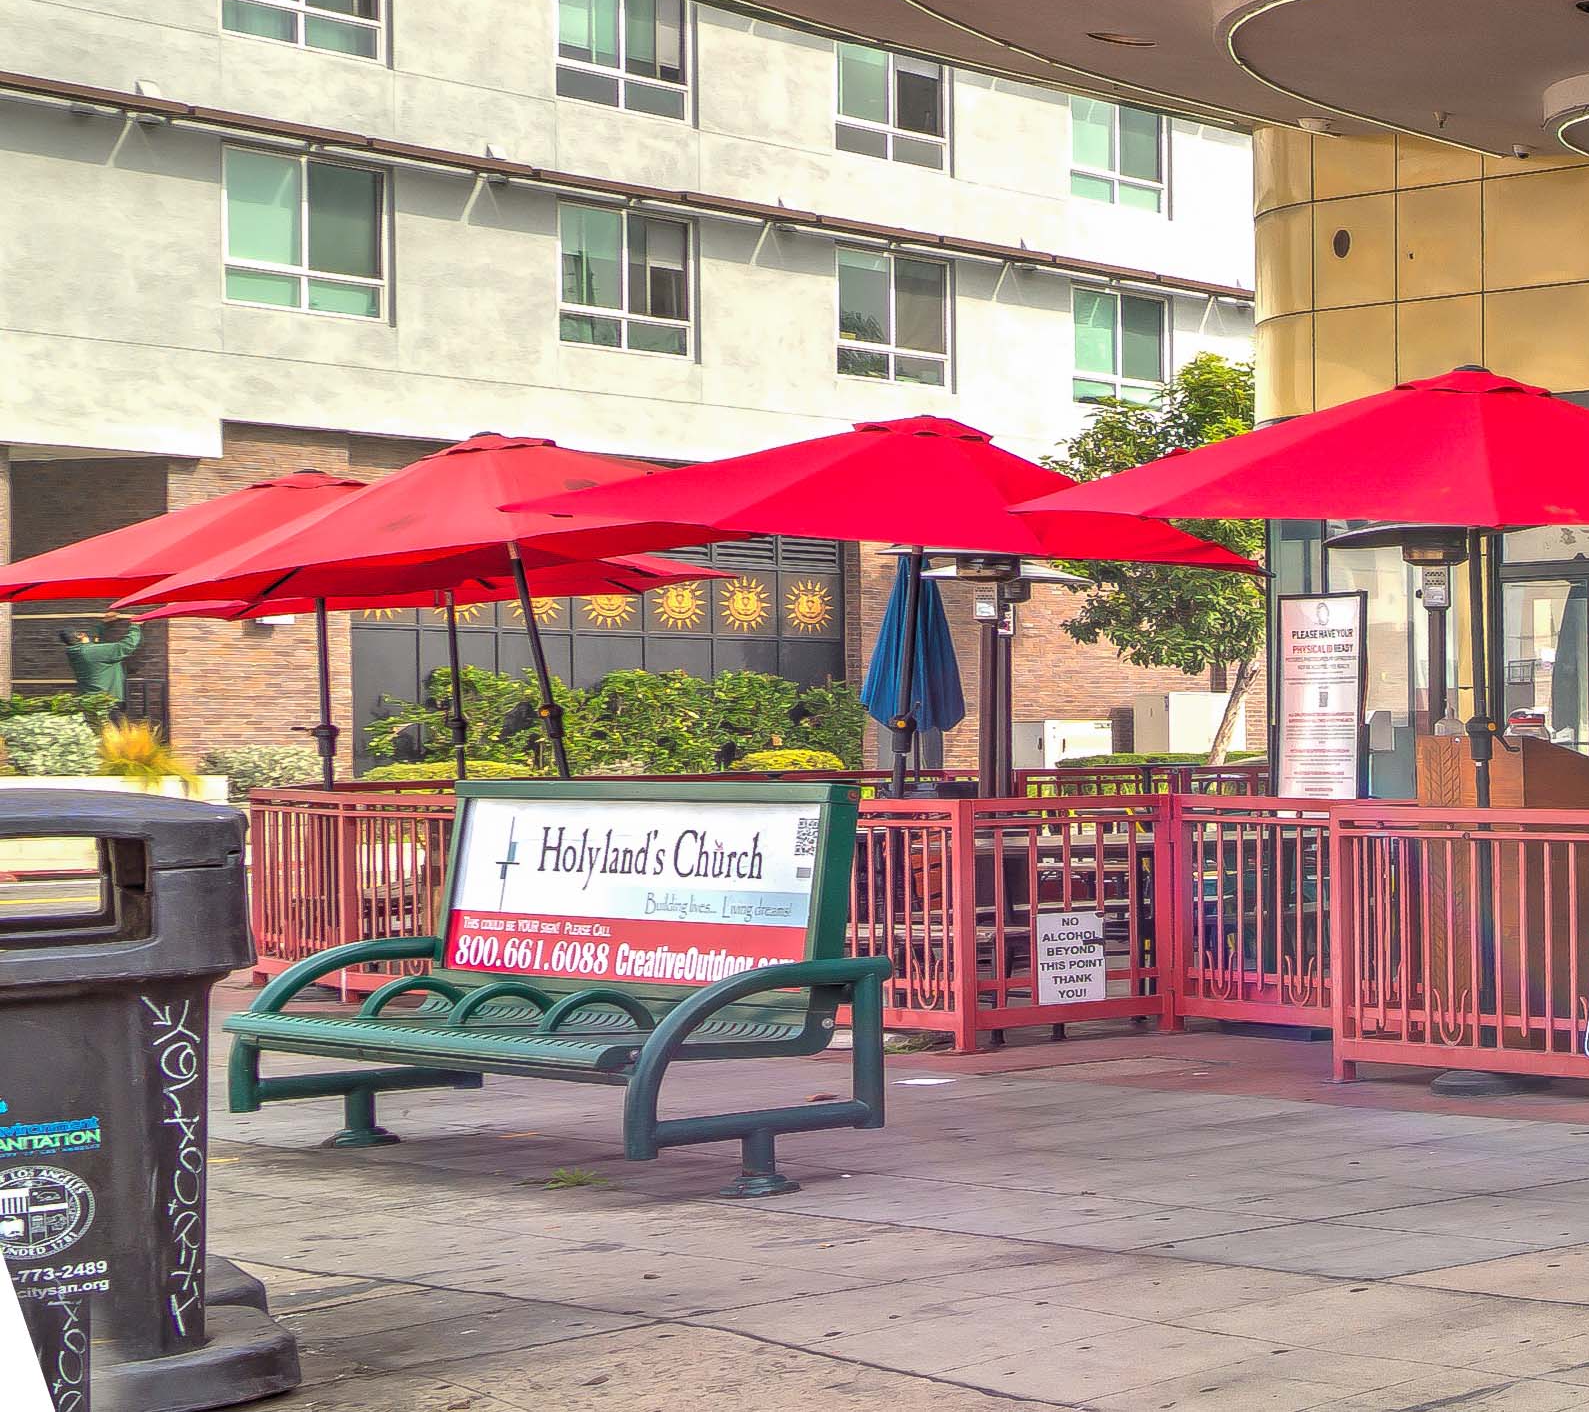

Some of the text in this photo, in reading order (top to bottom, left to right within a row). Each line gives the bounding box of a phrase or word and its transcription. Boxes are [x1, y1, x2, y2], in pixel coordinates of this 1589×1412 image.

[1292, 629, 1353, 639] PLEASE HAVE YOUR
[537, 826, 763, 890] Holyland's Church
[518, 919, 539, 933] YOUR
[1061, 918, 1079, 926] NO
[1042, 931, 1098, 942] ALCOHOL
[1047, 945, 1095, 956] BEYOND
[455, 934, 797, 982] 800.661.6088 CreativeOutdoor
[1040, 959, 1103, 971] THIS POINT
[1052, 974, 1092, 984] THANK
[1059, 989, 1086, 998] YOU!
